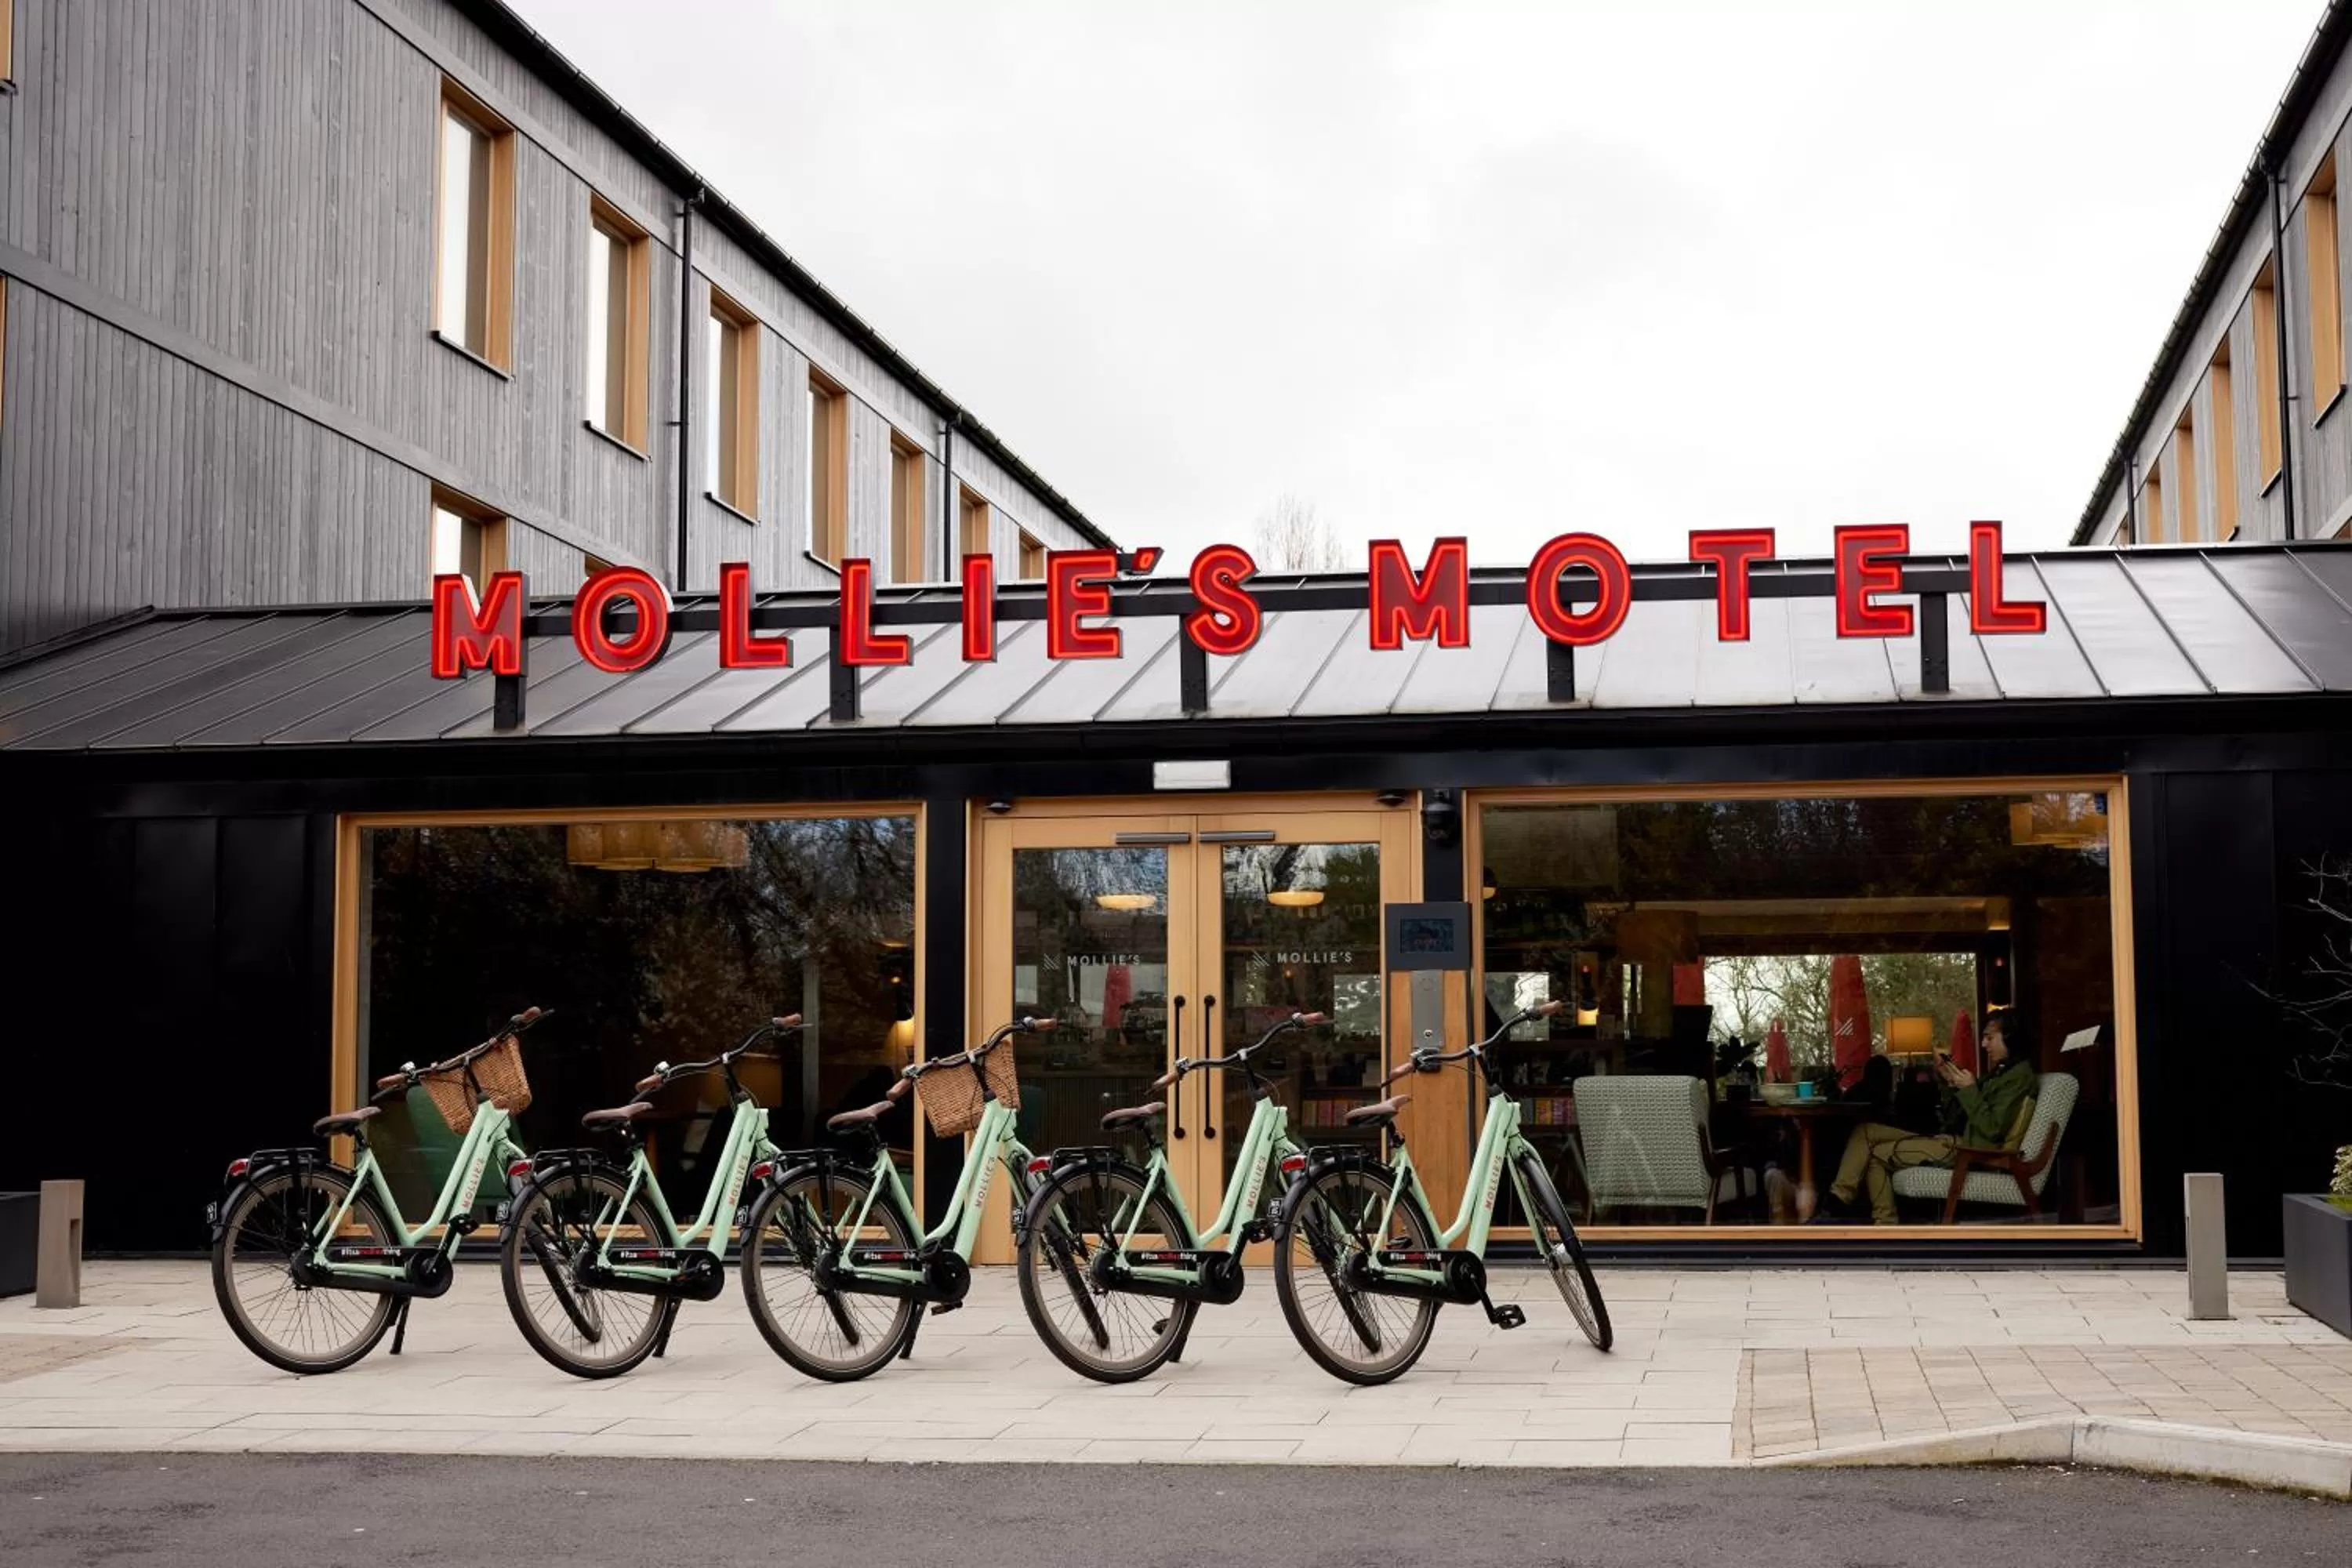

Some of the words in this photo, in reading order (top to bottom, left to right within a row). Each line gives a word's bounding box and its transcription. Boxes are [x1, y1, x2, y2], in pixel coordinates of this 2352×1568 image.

[431, 544, 1261, 679] MOLLIE'S
[1368, 520, 2047, 651] MOTEL
[1067, 953, 1141, 967] MOLLIE'S
[1277, 951, 1353, 964] MOLLIE'S
[1246, 1155, 1268, 1209] MOLLIE'S
